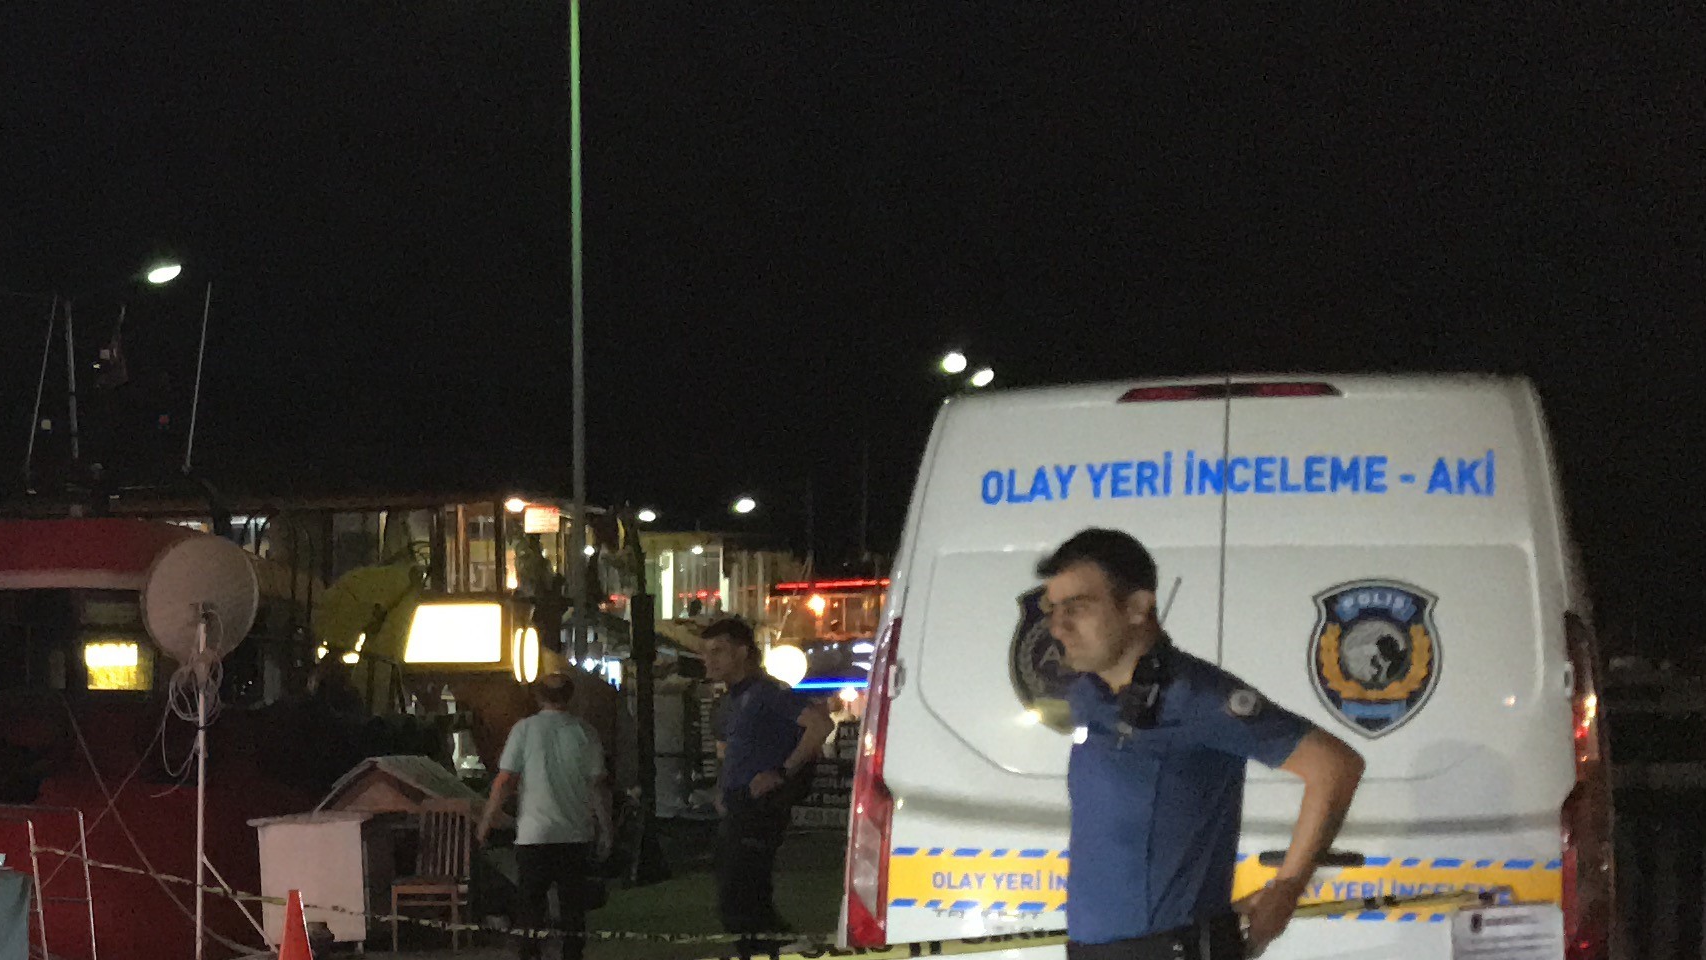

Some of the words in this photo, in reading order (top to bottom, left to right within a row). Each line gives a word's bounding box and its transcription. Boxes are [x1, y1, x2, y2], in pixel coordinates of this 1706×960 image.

[980, 463, 1077, 506] OLAY
[1086, 450, 1174, 499] YERİ
[1183, 449, 1388, 496] İNCELEME
[1425, 448, 1495, 497] AKİ
[932, 871, 986, 890] OLAY
[993, 869, 1042, 891] YERİ
